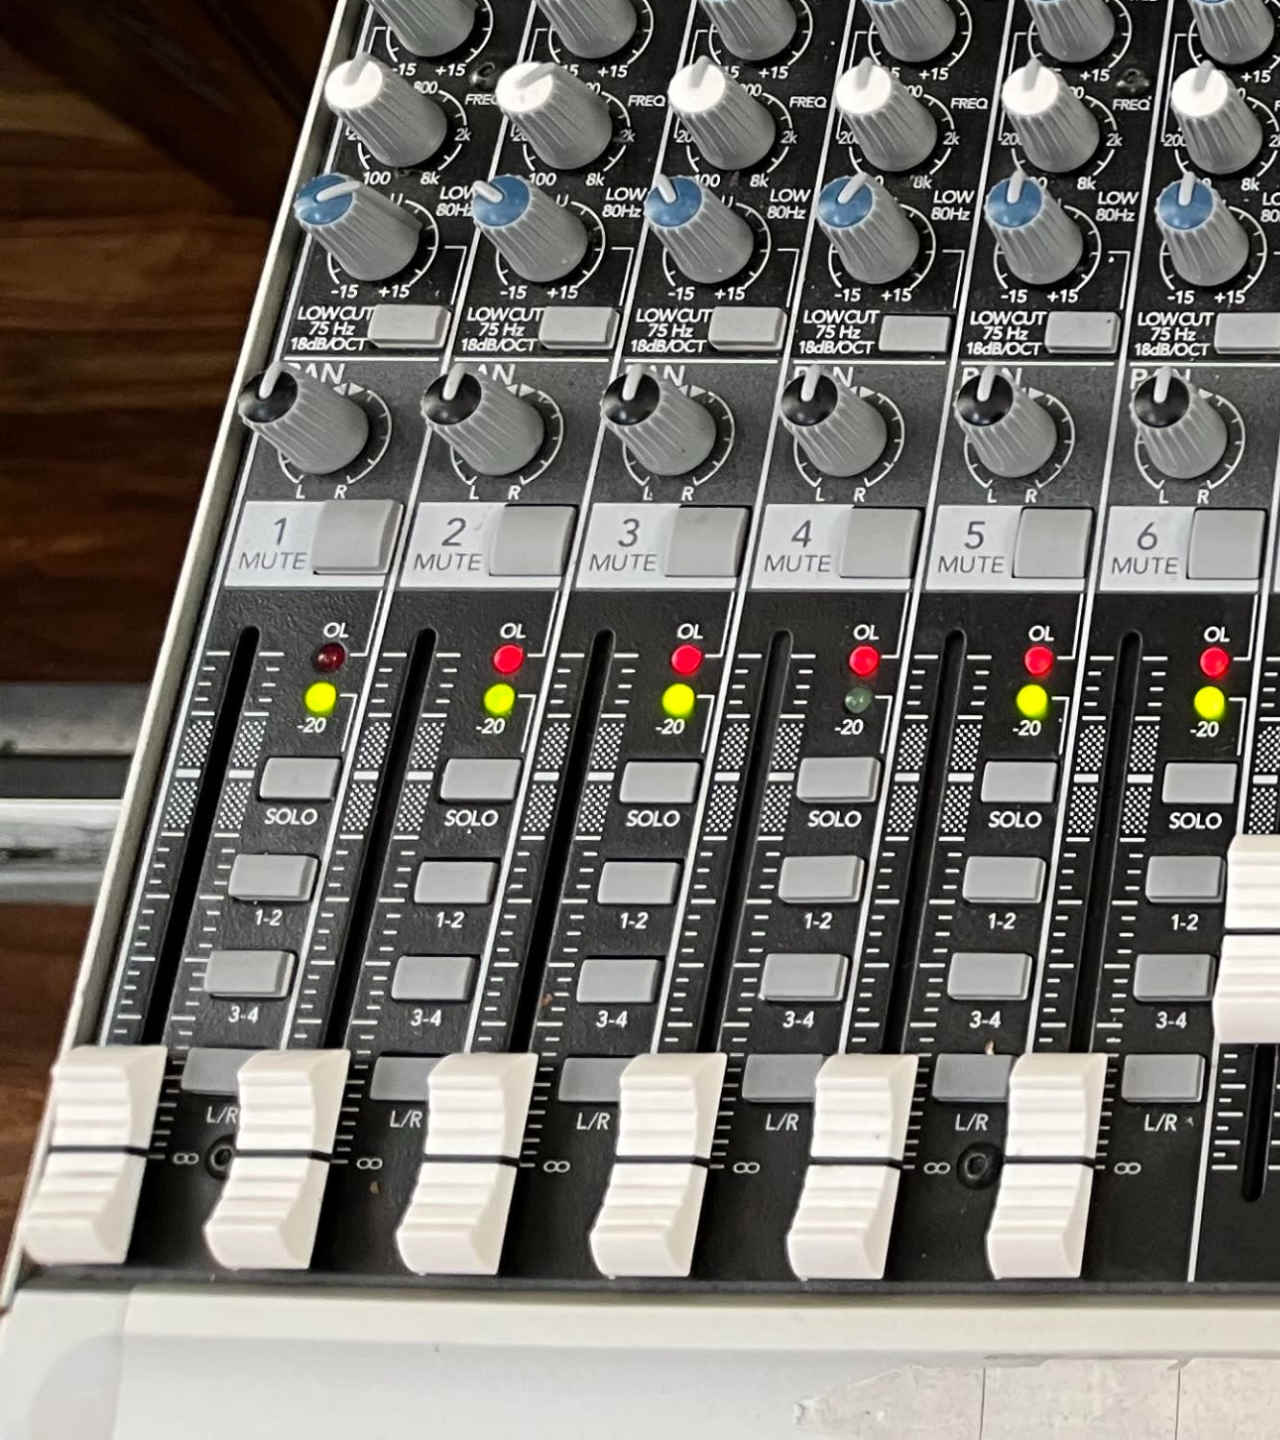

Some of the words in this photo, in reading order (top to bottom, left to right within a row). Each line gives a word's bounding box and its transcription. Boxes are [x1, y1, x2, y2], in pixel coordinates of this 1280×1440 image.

[790, 97, 826, 108] FREQ
[770, 189, 811, 202] LOW
[767, 206, 805, 219] 80Hz
[275, 518, 286, 544] 1
[239, 552, 307, 569] MUTE
[808, 811, 861, 827] SOLO
